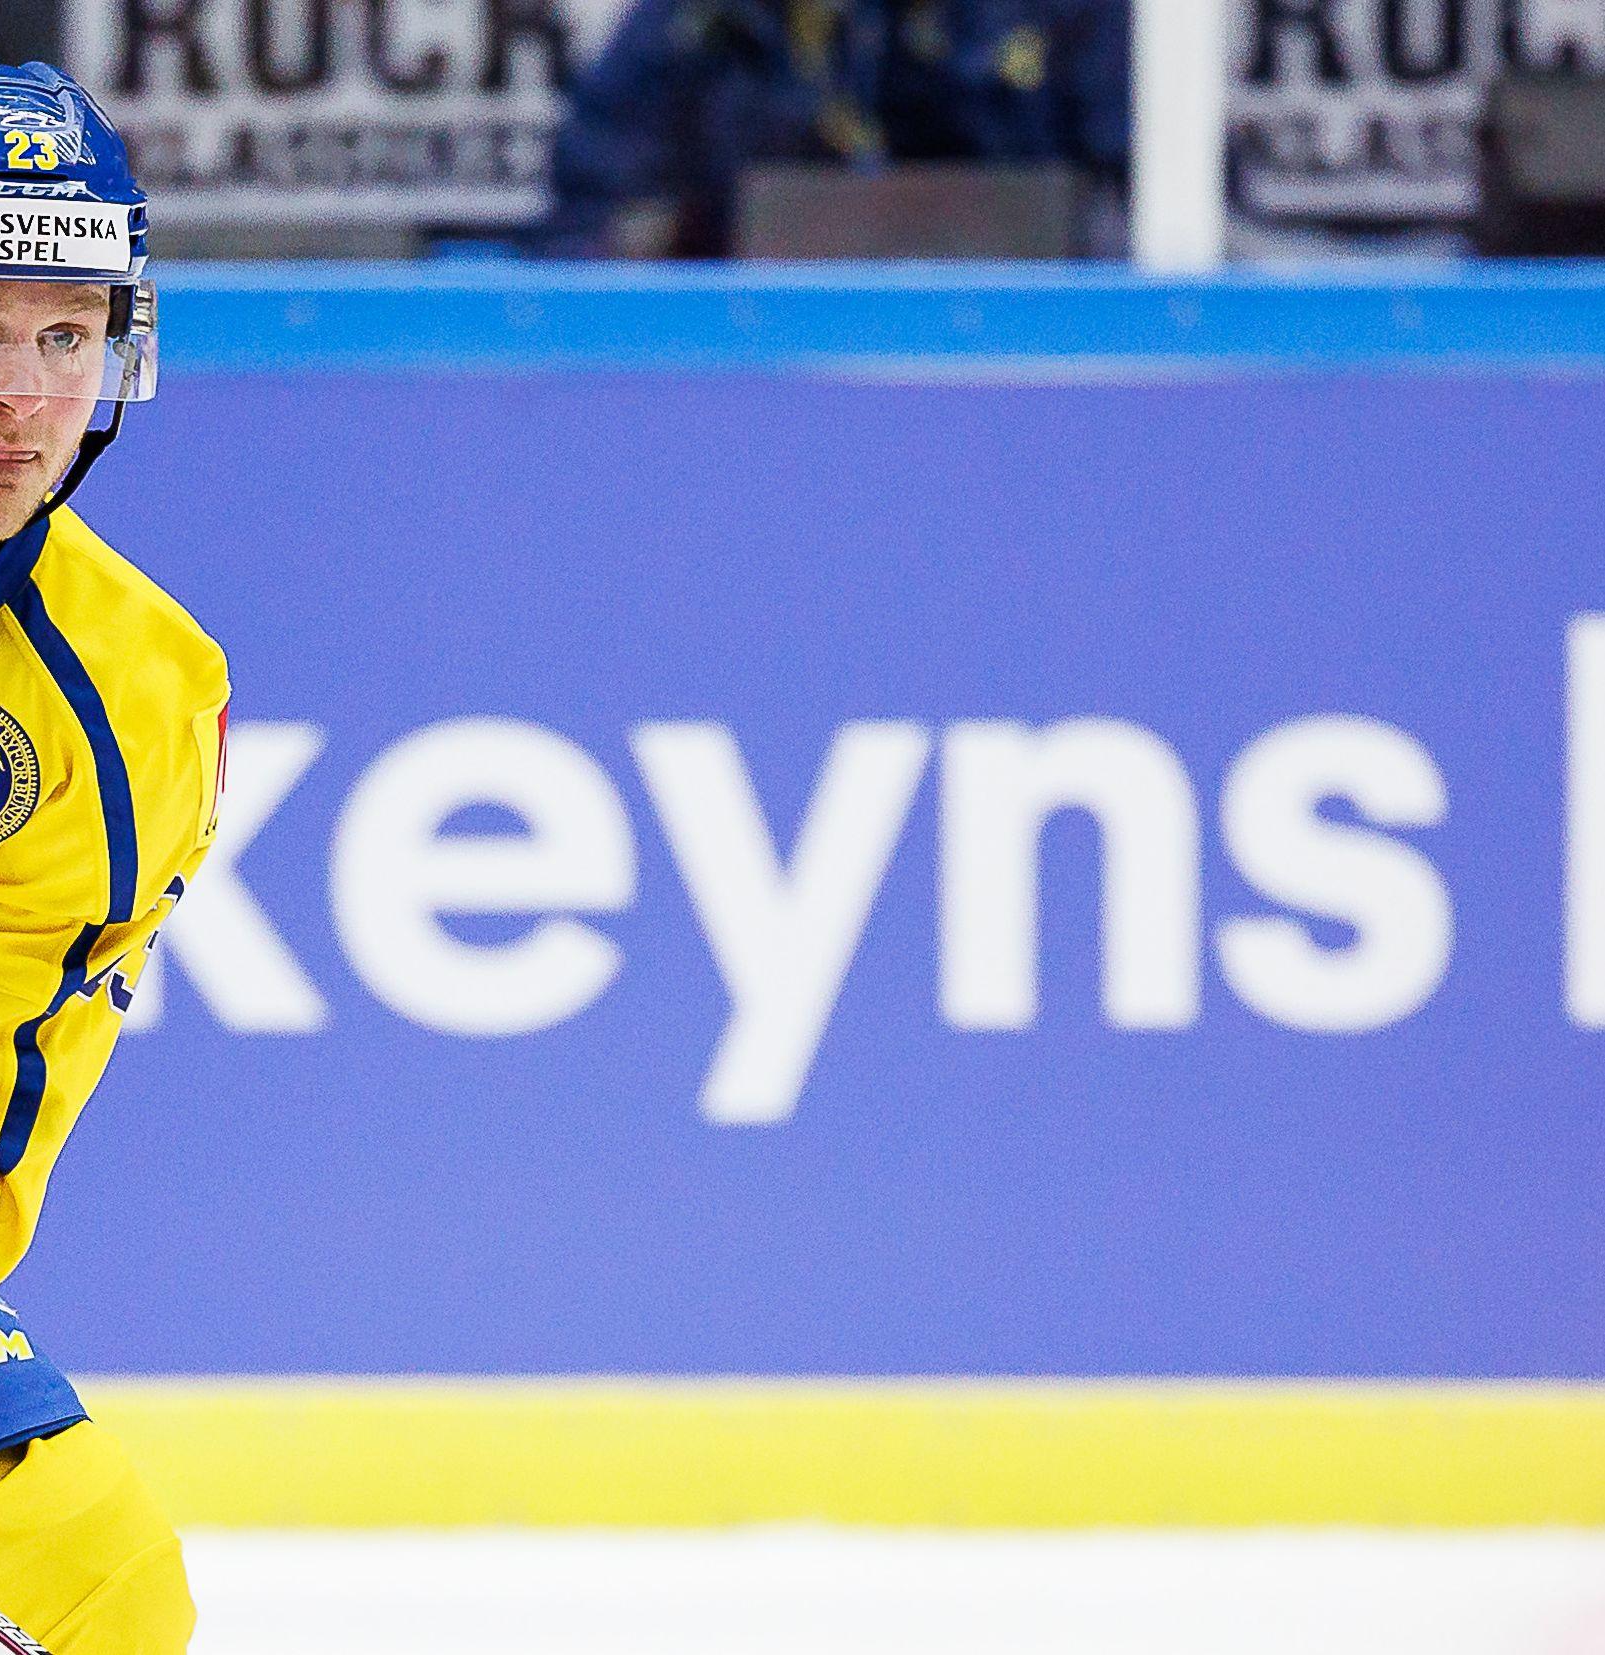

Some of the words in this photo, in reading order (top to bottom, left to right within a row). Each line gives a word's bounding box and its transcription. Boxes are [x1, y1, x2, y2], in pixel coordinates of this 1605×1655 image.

[4, 129, 60, 171] 23
[0, 213, 118, 241] SVENSKA
[0, 239, 67, 263] SPEL
